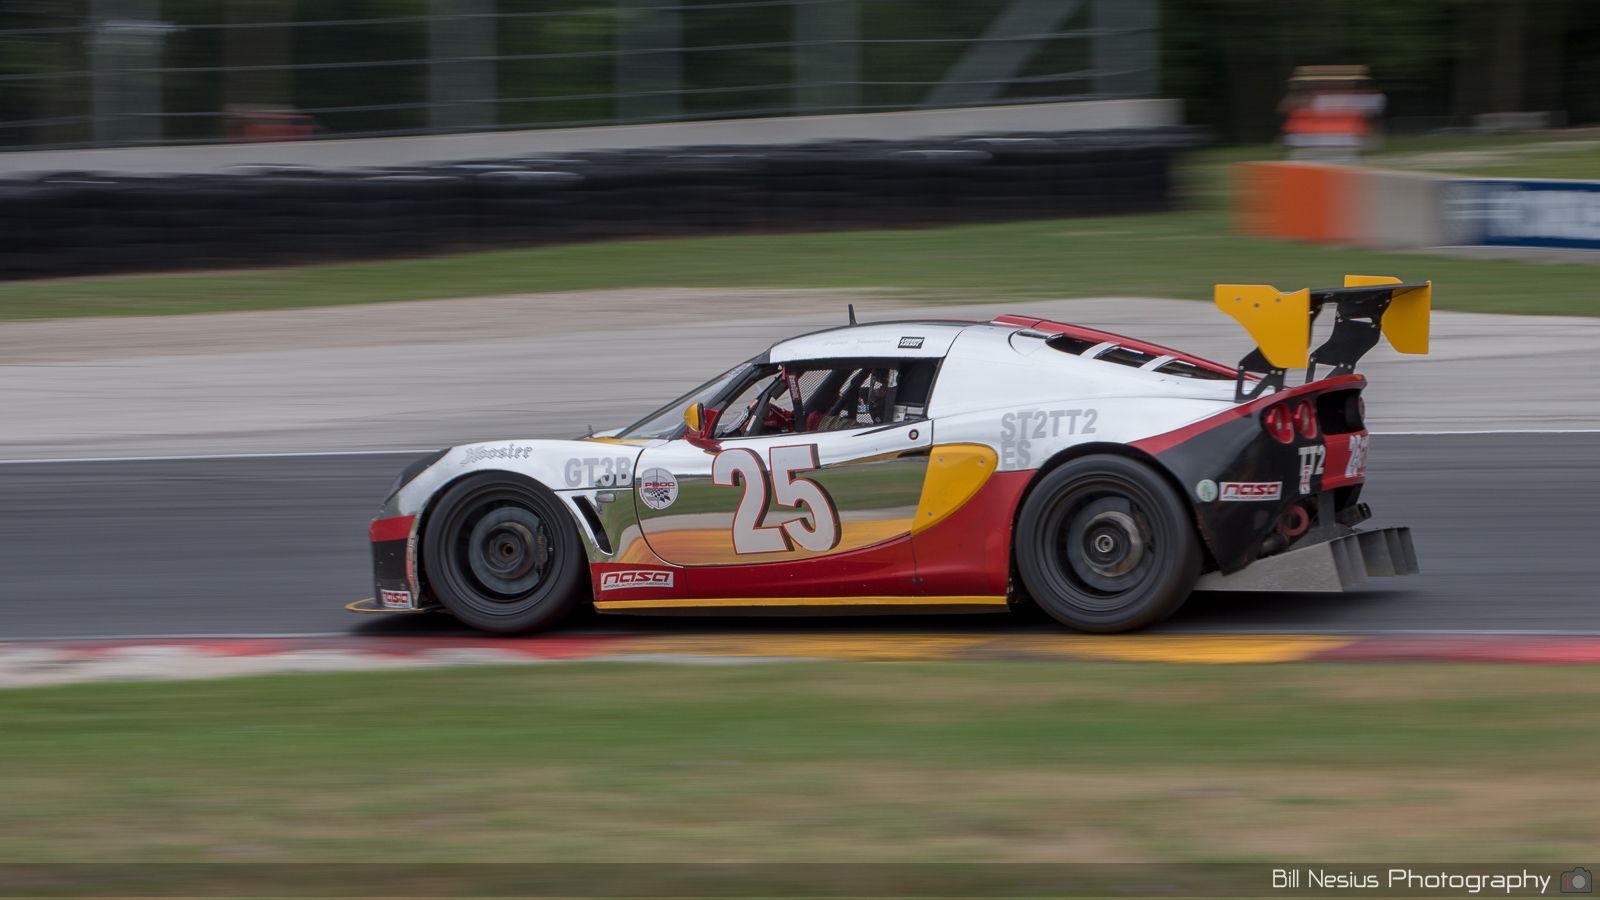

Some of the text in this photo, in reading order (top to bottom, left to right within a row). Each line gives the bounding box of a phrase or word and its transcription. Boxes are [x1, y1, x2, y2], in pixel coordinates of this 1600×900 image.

[1000, 408, 1098, 440] ST2TT2
[459, 443, 533, 467] Hoosier
[1001, 440, 1031, 470] ES
[1298, 445, 1326, 476] TT2
[564, 457, 632, 487] GT3B
[712, 443, 842, 555] 25
[603, 572, 670, 584] nasa
